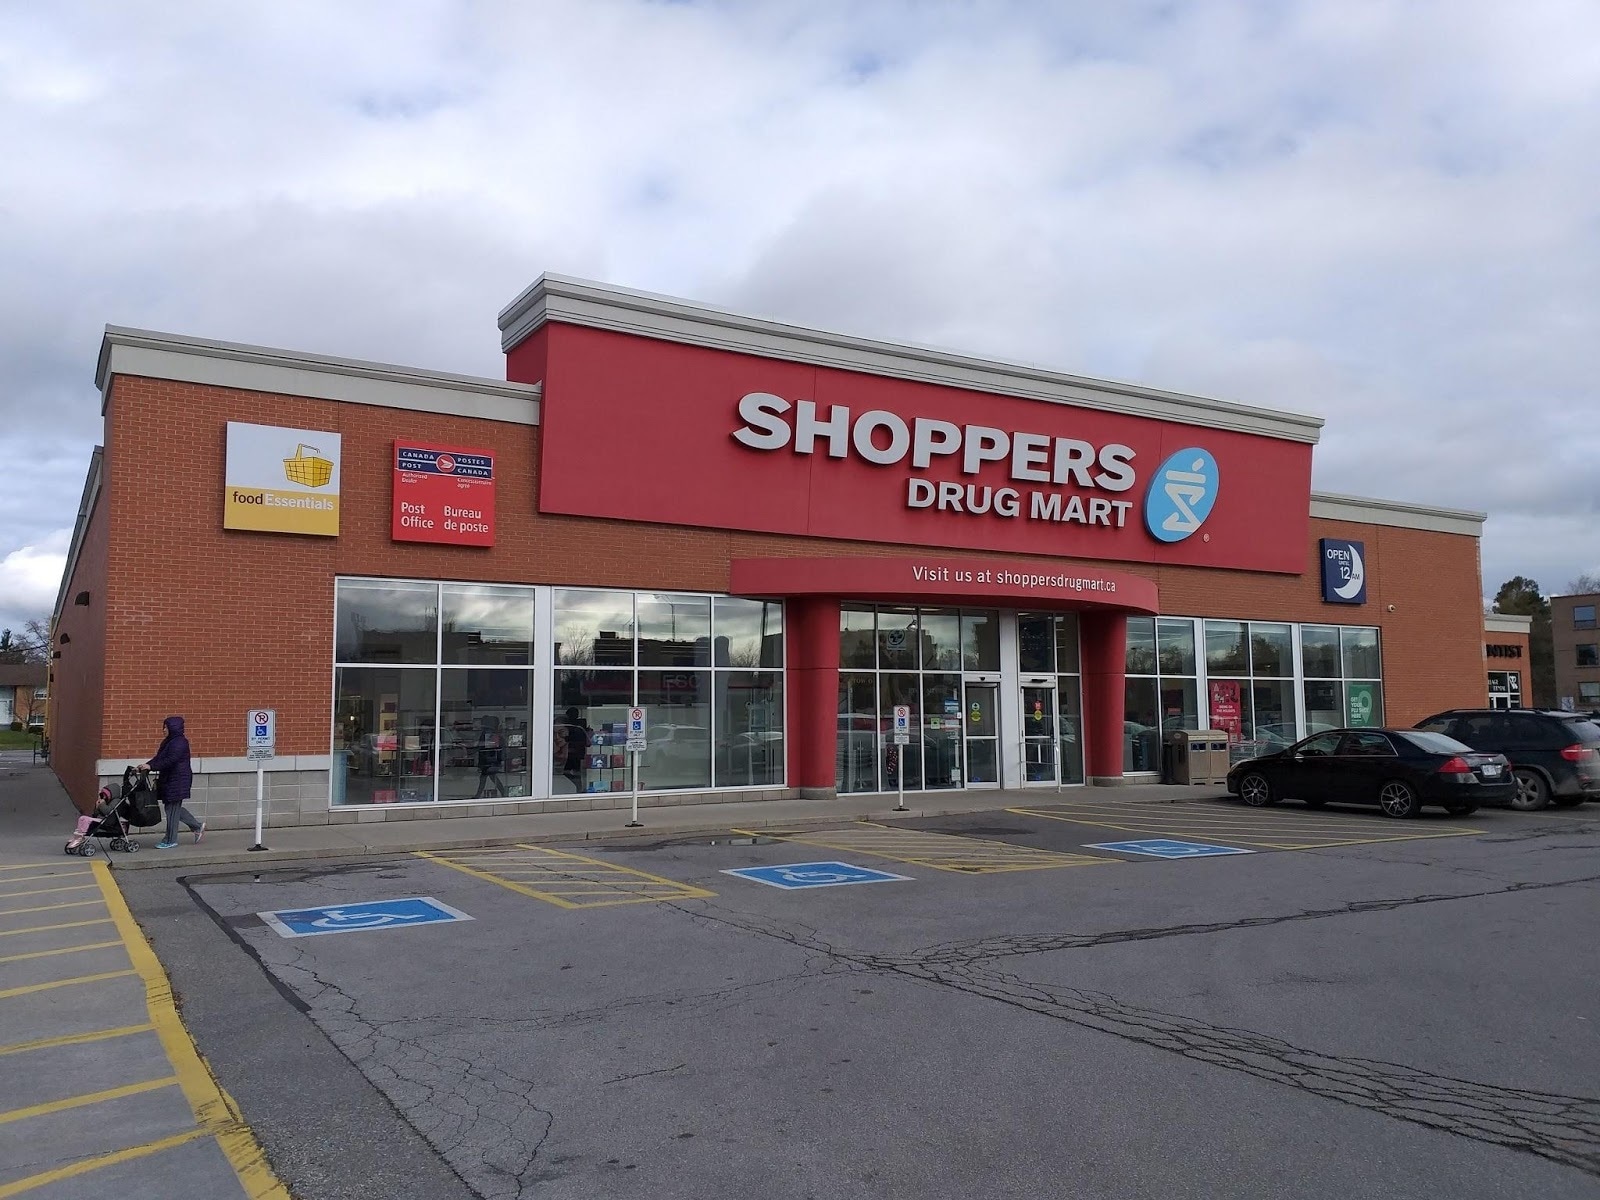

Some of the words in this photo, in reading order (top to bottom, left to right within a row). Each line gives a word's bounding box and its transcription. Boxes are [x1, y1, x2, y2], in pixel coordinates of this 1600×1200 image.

[732, 392, 1137, 492] SHOPPERS
[402, 451, 435, 460] CANADA
[457, 457, 485, 466] POSTES
[402, 462, 422, 470] POST
[457, 468, 489, 477] CANADA
[233, 491, 263, 505] food
[264, 493, 334, 510] Essentials
[907, 477, 1020, 517] DRUG
[1030, 491, 1133, 527] MART
[401, 502, 426, 515] Post
[443, 505, 482, 519] Bureau
[401, 516, 434, 529] Office
[443, 519, 458, 531] de
[459, 522, 489, 533] poste
[1326, 549, 1350, 560] OPEN
[912, 566, 949, 581] Visit
[955, 570, 972, 583] us
[976, 570, 991, 583] at
[996, 570, 1116, 592] shoppersdrugmart.ca
[1340, 566, 1351, 580] 12
[1486, 644, 1524, 659] NTIST
